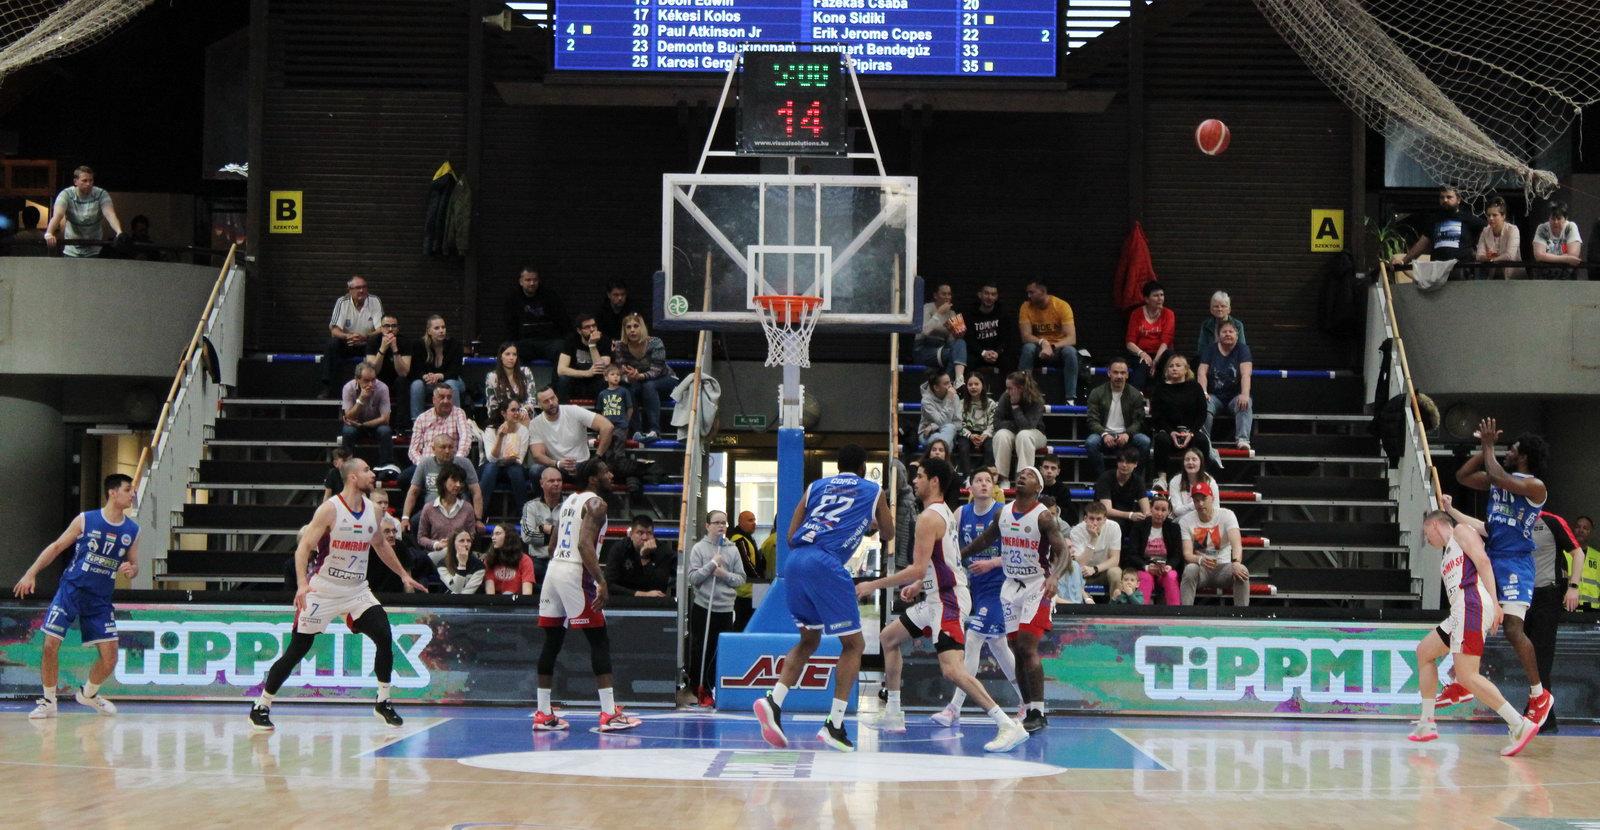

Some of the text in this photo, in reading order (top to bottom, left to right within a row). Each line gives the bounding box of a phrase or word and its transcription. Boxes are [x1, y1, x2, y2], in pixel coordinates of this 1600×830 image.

[867, 0, 909, 9] Csaba
[963, 0, 980, 11] 20
[633, 8, 741, 23] 17 Kékesi Kolos
[813, 12, 978, 26] Kone Sidiki 21
[566, 22, 762, 38] 4 20 Paul Atkinson Jr
[813, 28, 1050, 43] Erik Jerome Copes 22 2
[566, 38, 576, 51] 2
[632, 39, 649, 52] 23
[657, 40, 715, 53] Demonte
[866, 43, 931, 58] Bendegúz
[963, 44, 979, 57] 33
[632, 55, 649, 68] 25
[657, 56, 699, 69] Karosi
[963, 60, 979, 73] 35
[777, 100, 823, 138] 14
[753, 139, 830, 148] www.visualsolutions.hu
[276, 198, 297, 221] B
[1315, 217, 1340, 240] A
[974, 319, 999, 331] TOMMY
[811, 494, 855, 523] 22
[102, 541, 115, 555] 17
[347, 555, 358, 569] 7
[1010, 550, 1022, 565] 23
[47, 610, 60, 625] 17
[312, 603, 320, 617] 7
